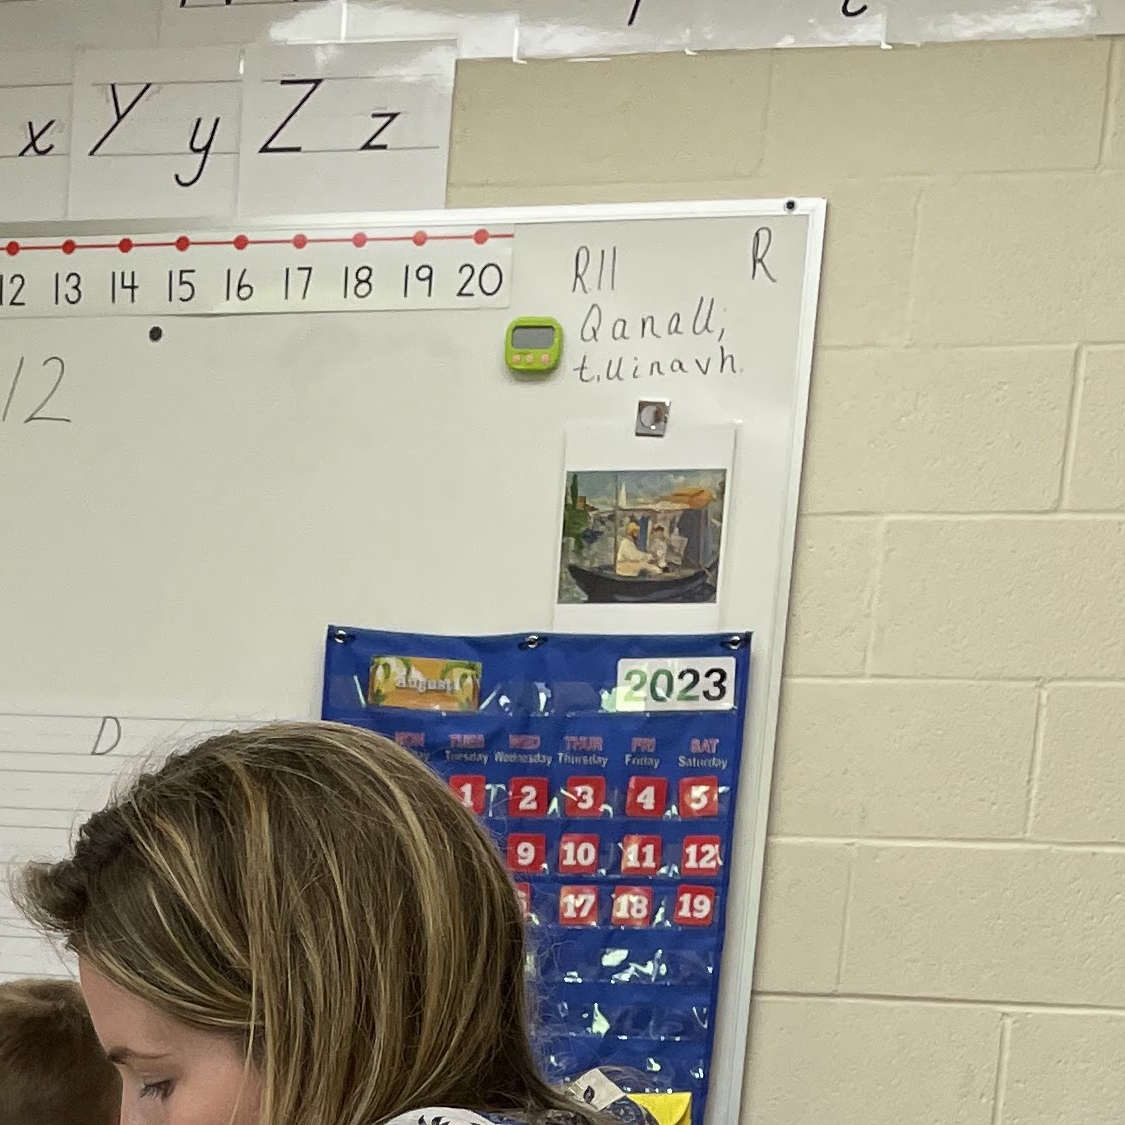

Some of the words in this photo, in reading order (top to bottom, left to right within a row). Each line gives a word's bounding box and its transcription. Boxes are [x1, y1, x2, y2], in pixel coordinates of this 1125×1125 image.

[17, 118, 57, 157] x
[87, 82, 153, 157] Y
[174, 116, 221, 188] y
[257, 77, 325, 154] Z
[359, 111, 402, 151] z
[751, 226, 778, 284] R
[53, 271, 82, 305] 13
[110, 269, 139, 304] 14
[167, 268, 196, 303] 15
[225, 267, 255, 301] 16
[283, 266, 314, 300] 17
[343, 265, 373, 299] 18
[403, 263, 434, 298] 19
[455, 262, 504, 297] 20
[2, 355, 73, 424] 12
[623, 667, 729, 703] 2023
[89, 716, 123, 756] D
[689, 738, 720, 754] SAT
[557, 752, 609, 768] Thursday
[625, 753, 661, 769] Friday
[678, 755, 728, 771] Saturday
[458, 782, 474, 804] 1
[518, 785, 538, 811] 2
[576, 785, 595, 810] 3
[636, 785, 656, 811] 4
[689, 785, 709, 810] 5
[516, 841, 536, 866] 9
[561, 841, 597, 866] 10
[625, 843, 657, 869] 11
[684, 843, 717, 869] 12
[562, 894, 596, 919] 17
[616, 893, 649, 918] 18
[677, 893, 712, 918] 19
